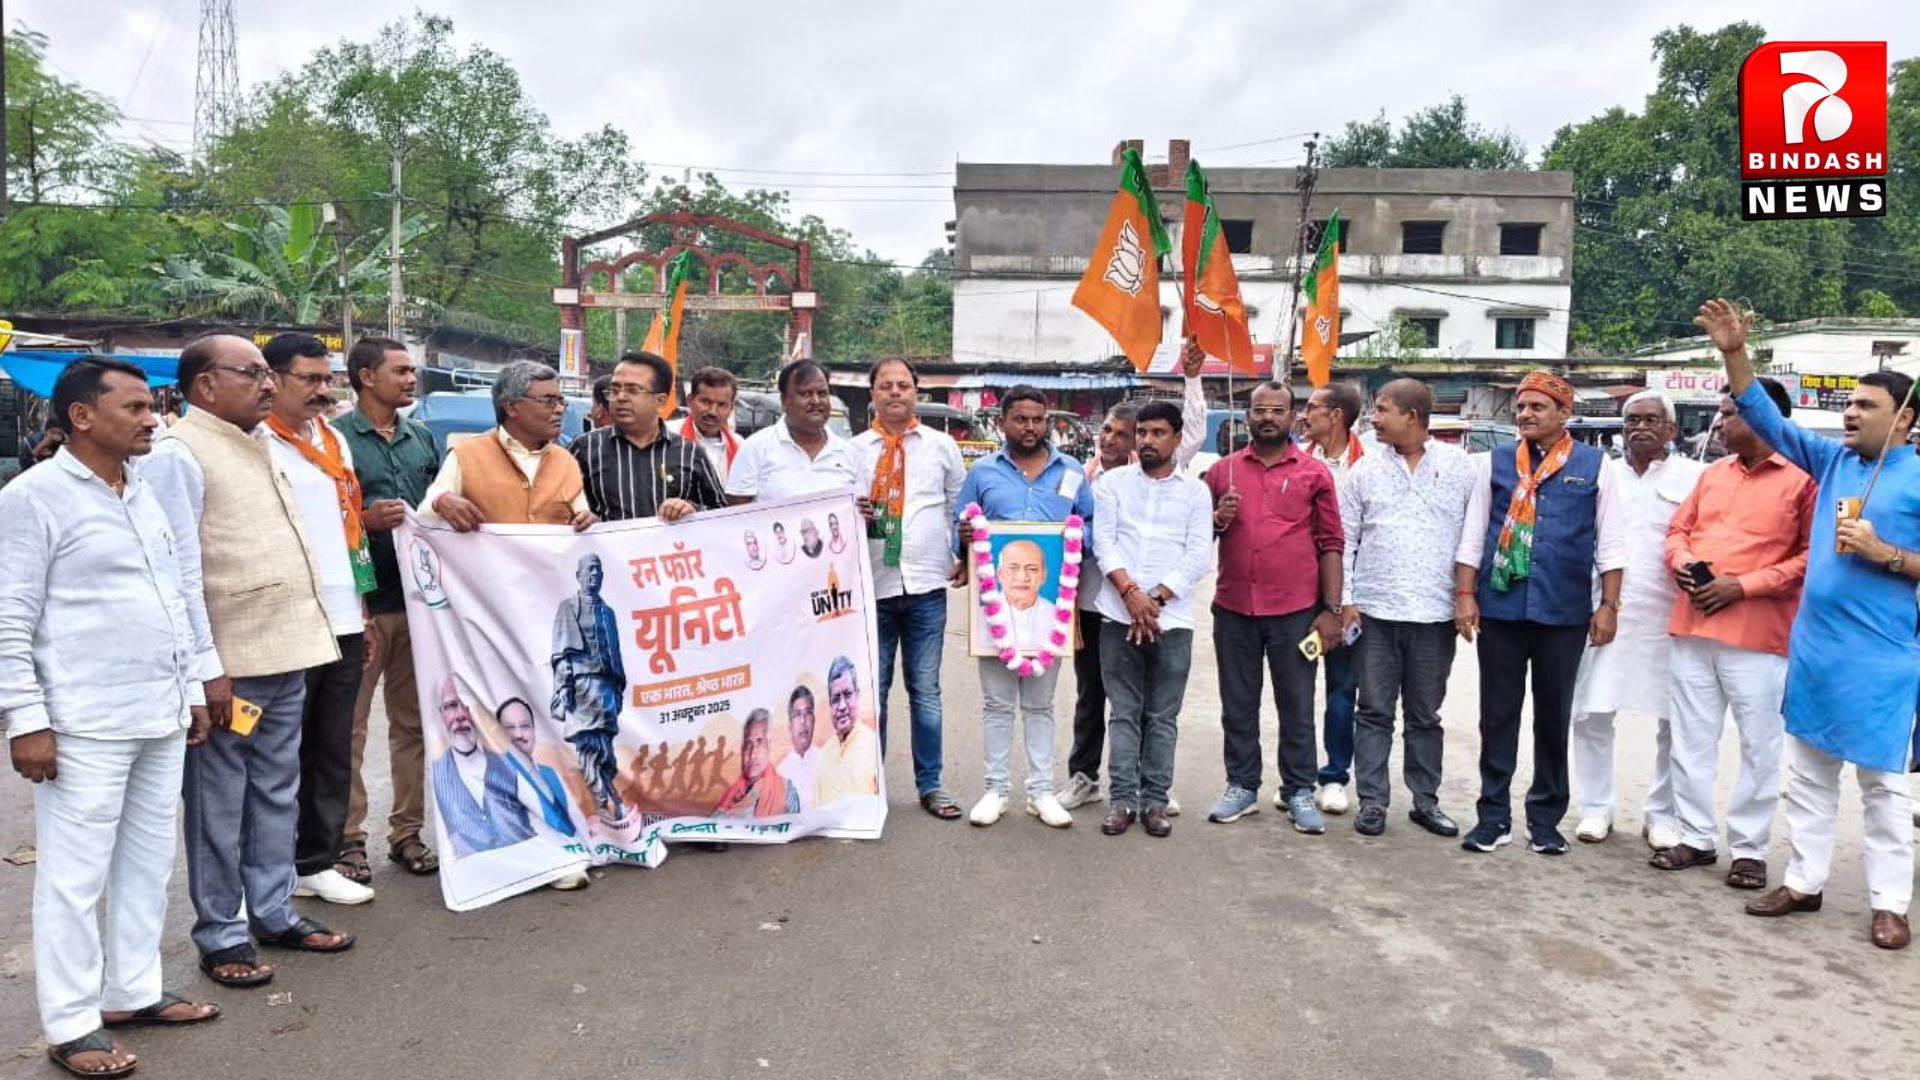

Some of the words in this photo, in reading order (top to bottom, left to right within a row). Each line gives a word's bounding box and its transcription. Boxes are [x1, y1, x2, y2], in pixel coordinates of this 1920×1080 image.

[629, 556, 661, 588] रन
[659, 541, 705, 582] फॉर
[632, 577, 746, 675] यूनिटी
[659, 711, 670, 724] 31
[707, 699, 731, 714] 2025
